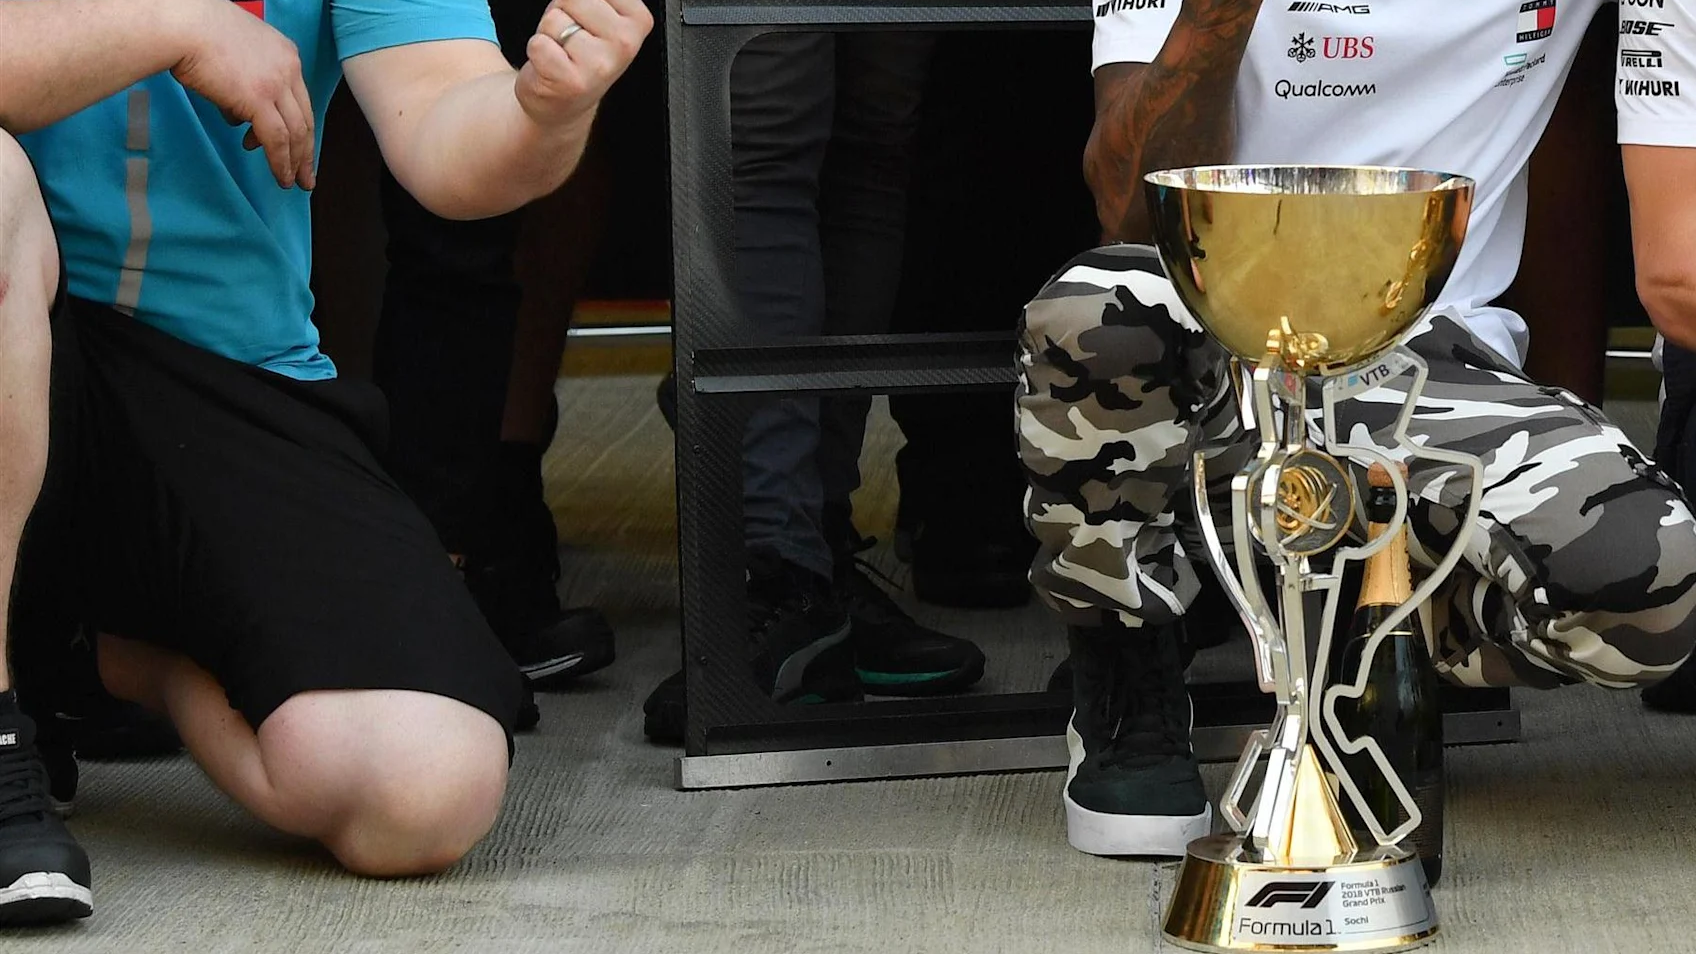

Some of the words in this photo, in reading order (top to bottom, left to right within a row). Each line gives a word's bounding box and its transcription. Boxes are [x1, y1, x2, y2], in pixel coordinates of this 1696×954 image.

[1317, 2, 1371, 15] AMG
[1322, 35, 1375, 60] UBS
[1621, 49, 1663, 68] RELLI
[1274, 79, 1377, 100] Qualcomm
[1360, 364, 1390, 386] VTB
[0, 733, 17, 746] CHE
[1341, 882, 1373, 890] Formula
[1341, 890, 1363, 899] 2018
[1364, 888, 1380, 897] VTB
[1342, 899, 1368, 908] Grand
[1370, 897, 1385, 905] Prix
[1239, 918, 1322, 936] Formula
[1344, 916, 1369, 926] Sochi
